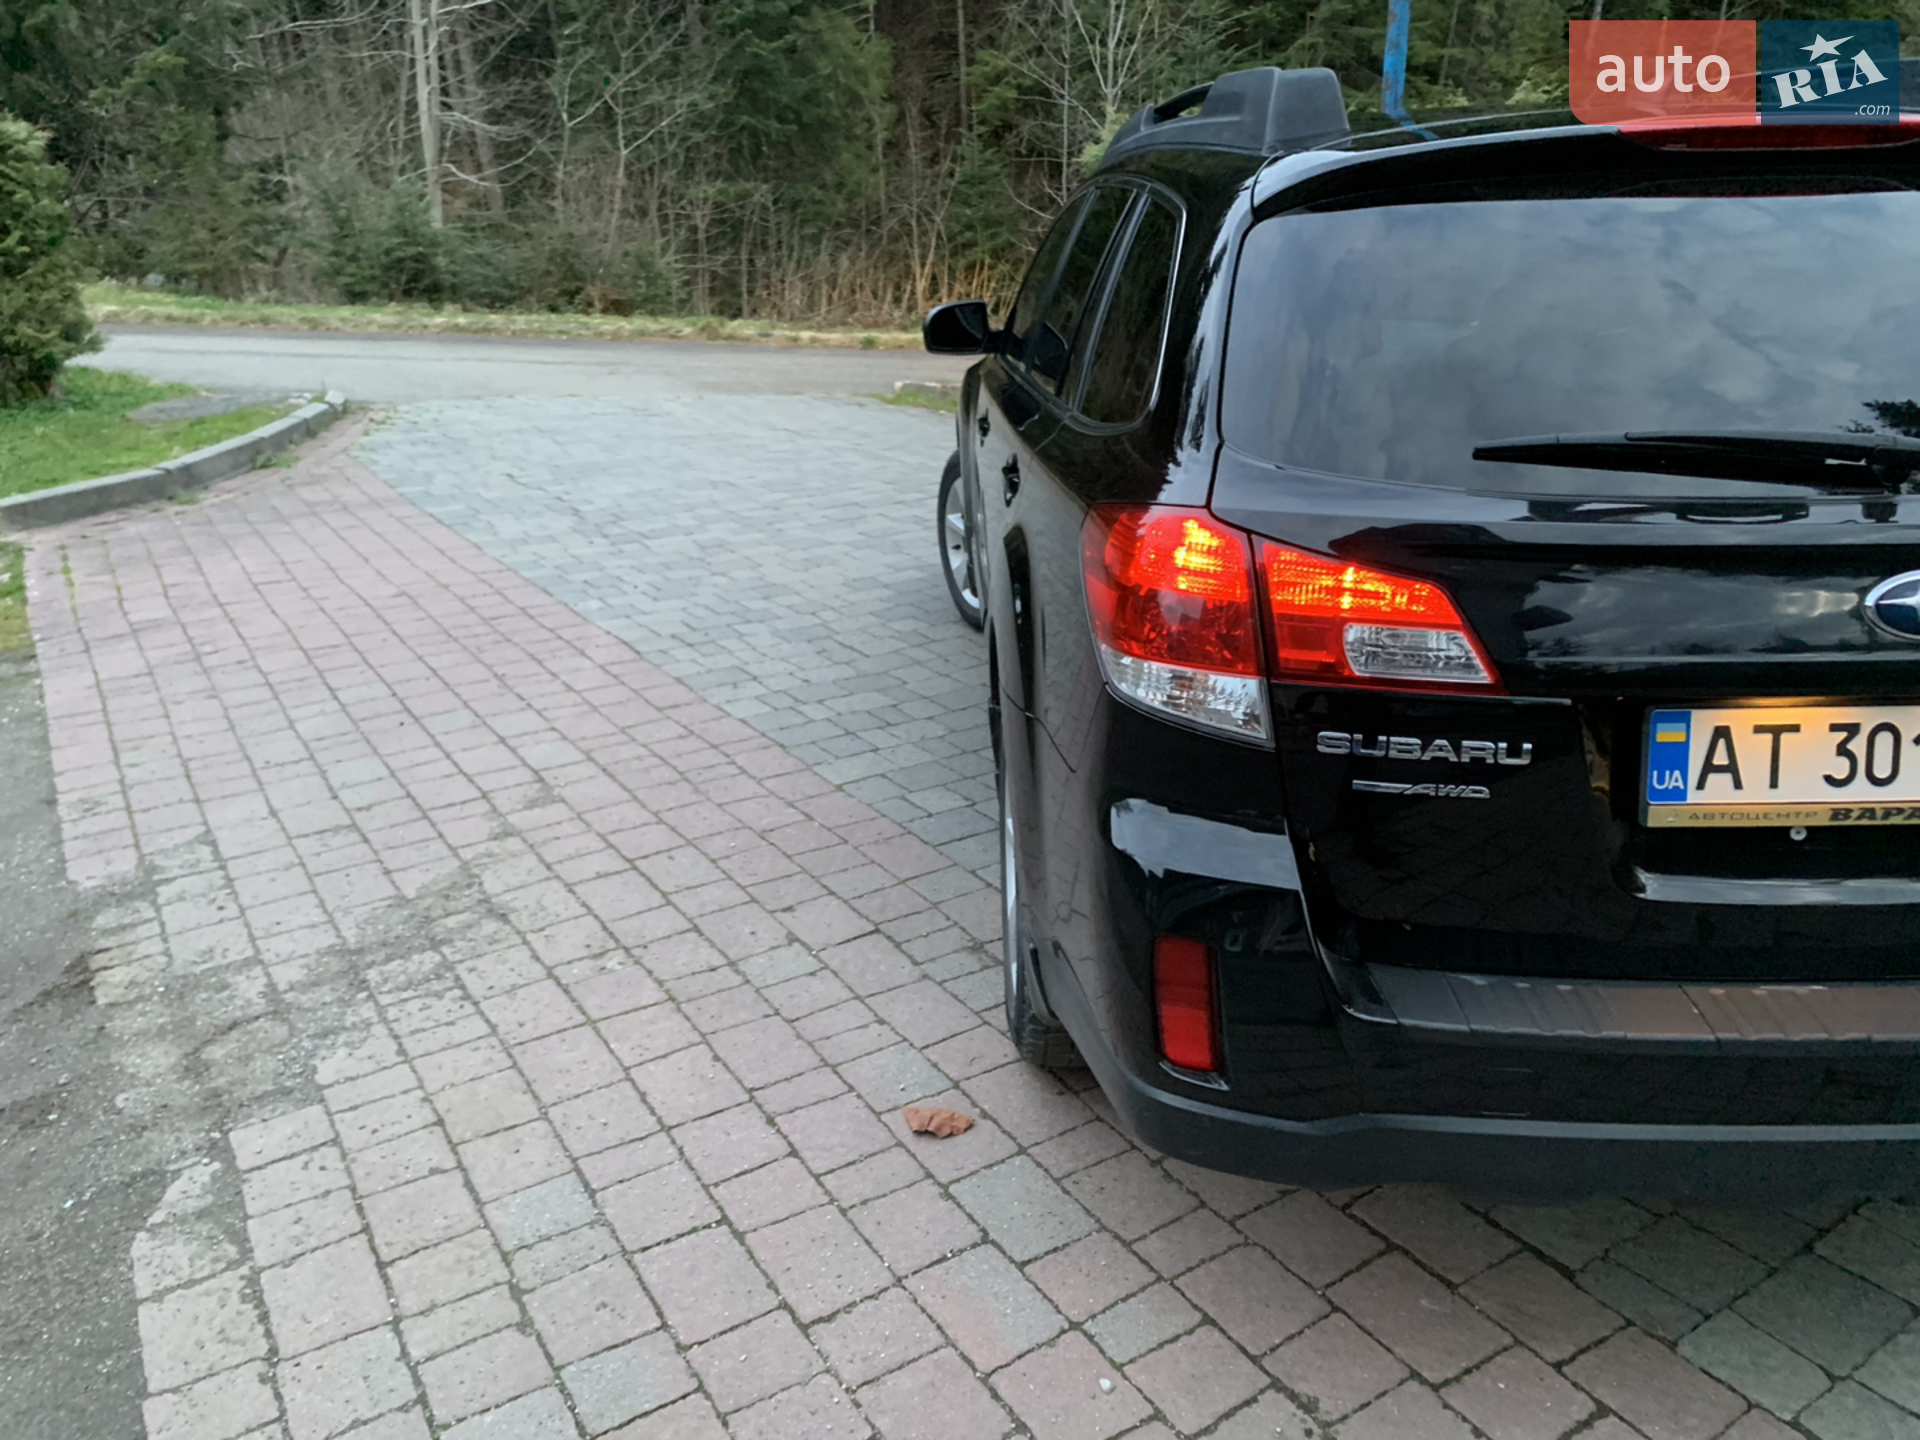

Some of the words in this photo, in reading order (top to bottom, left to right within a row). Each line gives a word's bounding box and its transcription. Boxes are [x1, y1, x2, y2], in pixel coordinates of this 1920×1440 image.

[1316, 731, 1533, 765] SUBARU
[1695, 723, 1801, 790] AT
[1822, 722, 1920, 788] 30
[1652, 770, 1685, 790] UA
[1404, 783, 1491, 798] AWD
[1688, 811, 1818, 821] АВТОЦЕНТР
